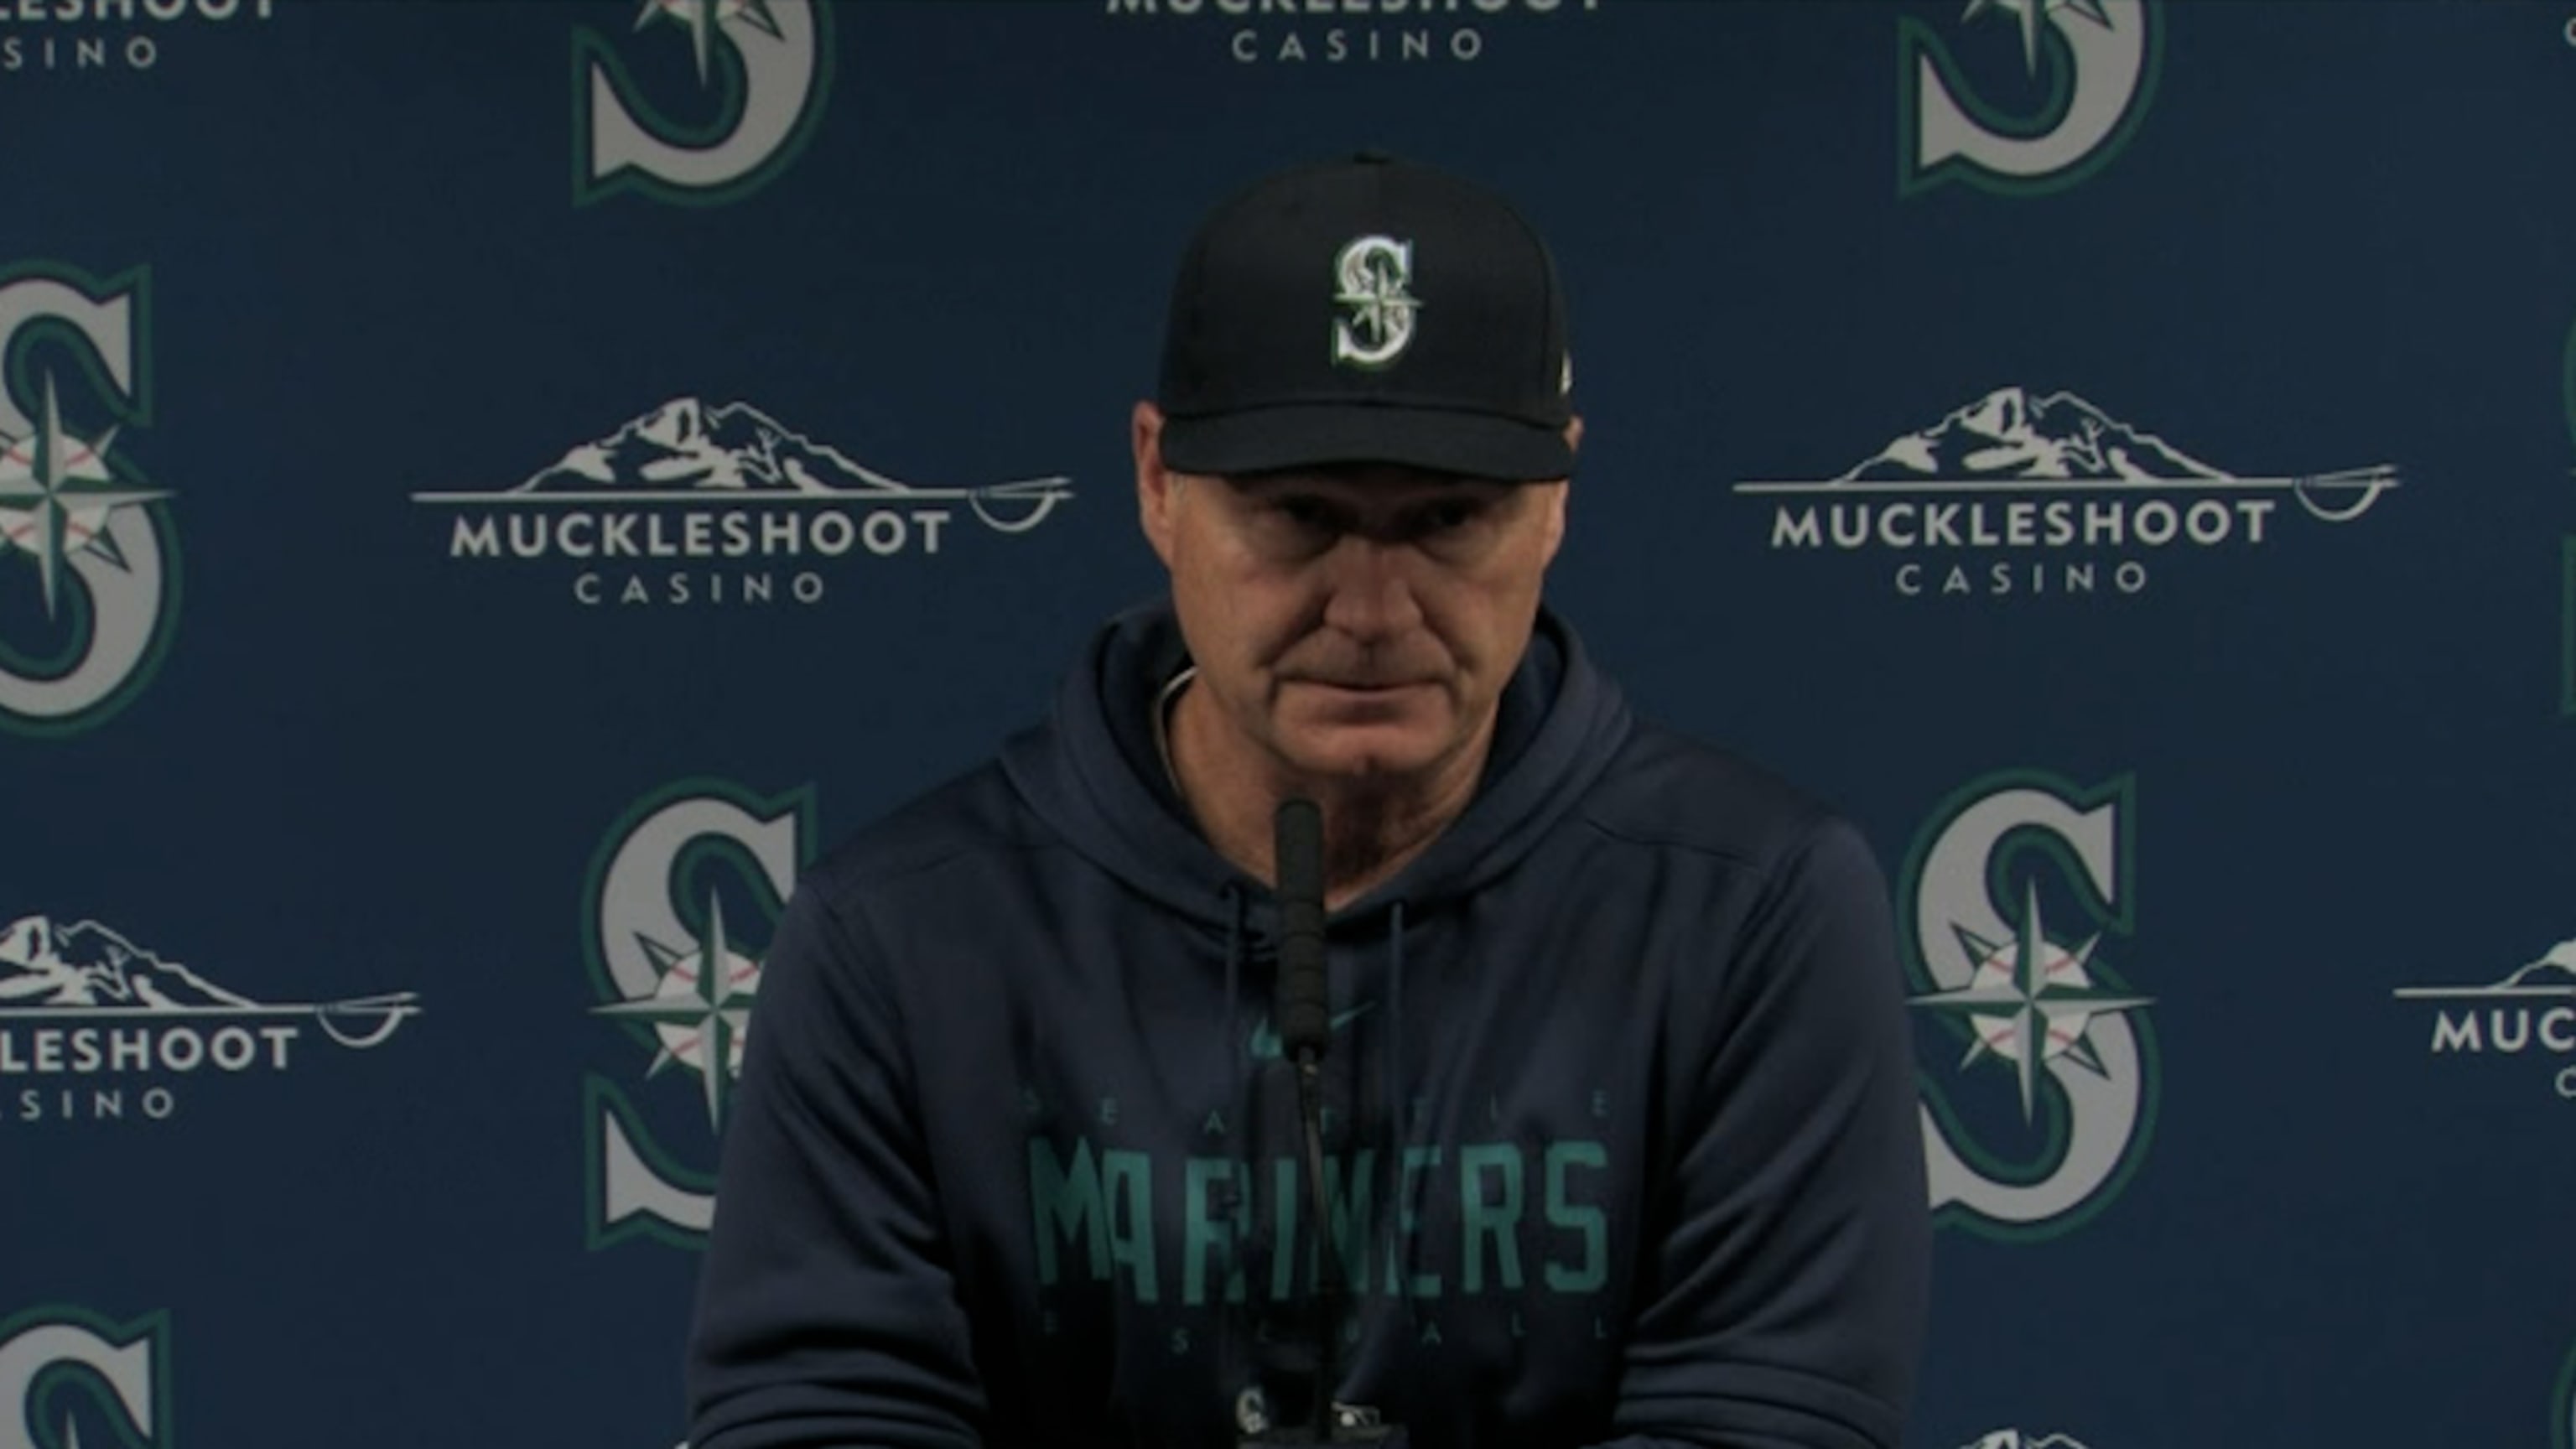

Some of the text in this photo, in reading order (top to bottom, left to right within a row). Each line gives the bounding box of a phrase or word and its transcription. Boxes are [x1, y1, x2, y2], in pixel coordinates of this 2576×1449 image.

[1233, 29, 1482, 60] CASINO
[450, 510, 951, 558] MUCKLESHOOT
[1771, 499, 2276, 548] MUCKLESHOOT
[574, 572, 823, 604] CASINO
[1896, 561, 2147, 595] CASINO
[0, 1026, 299, 1072] LESHOOT
[0, 1088, 174, 1120] SINO
[1028, 1135, 1609, 1305] MARINERS
